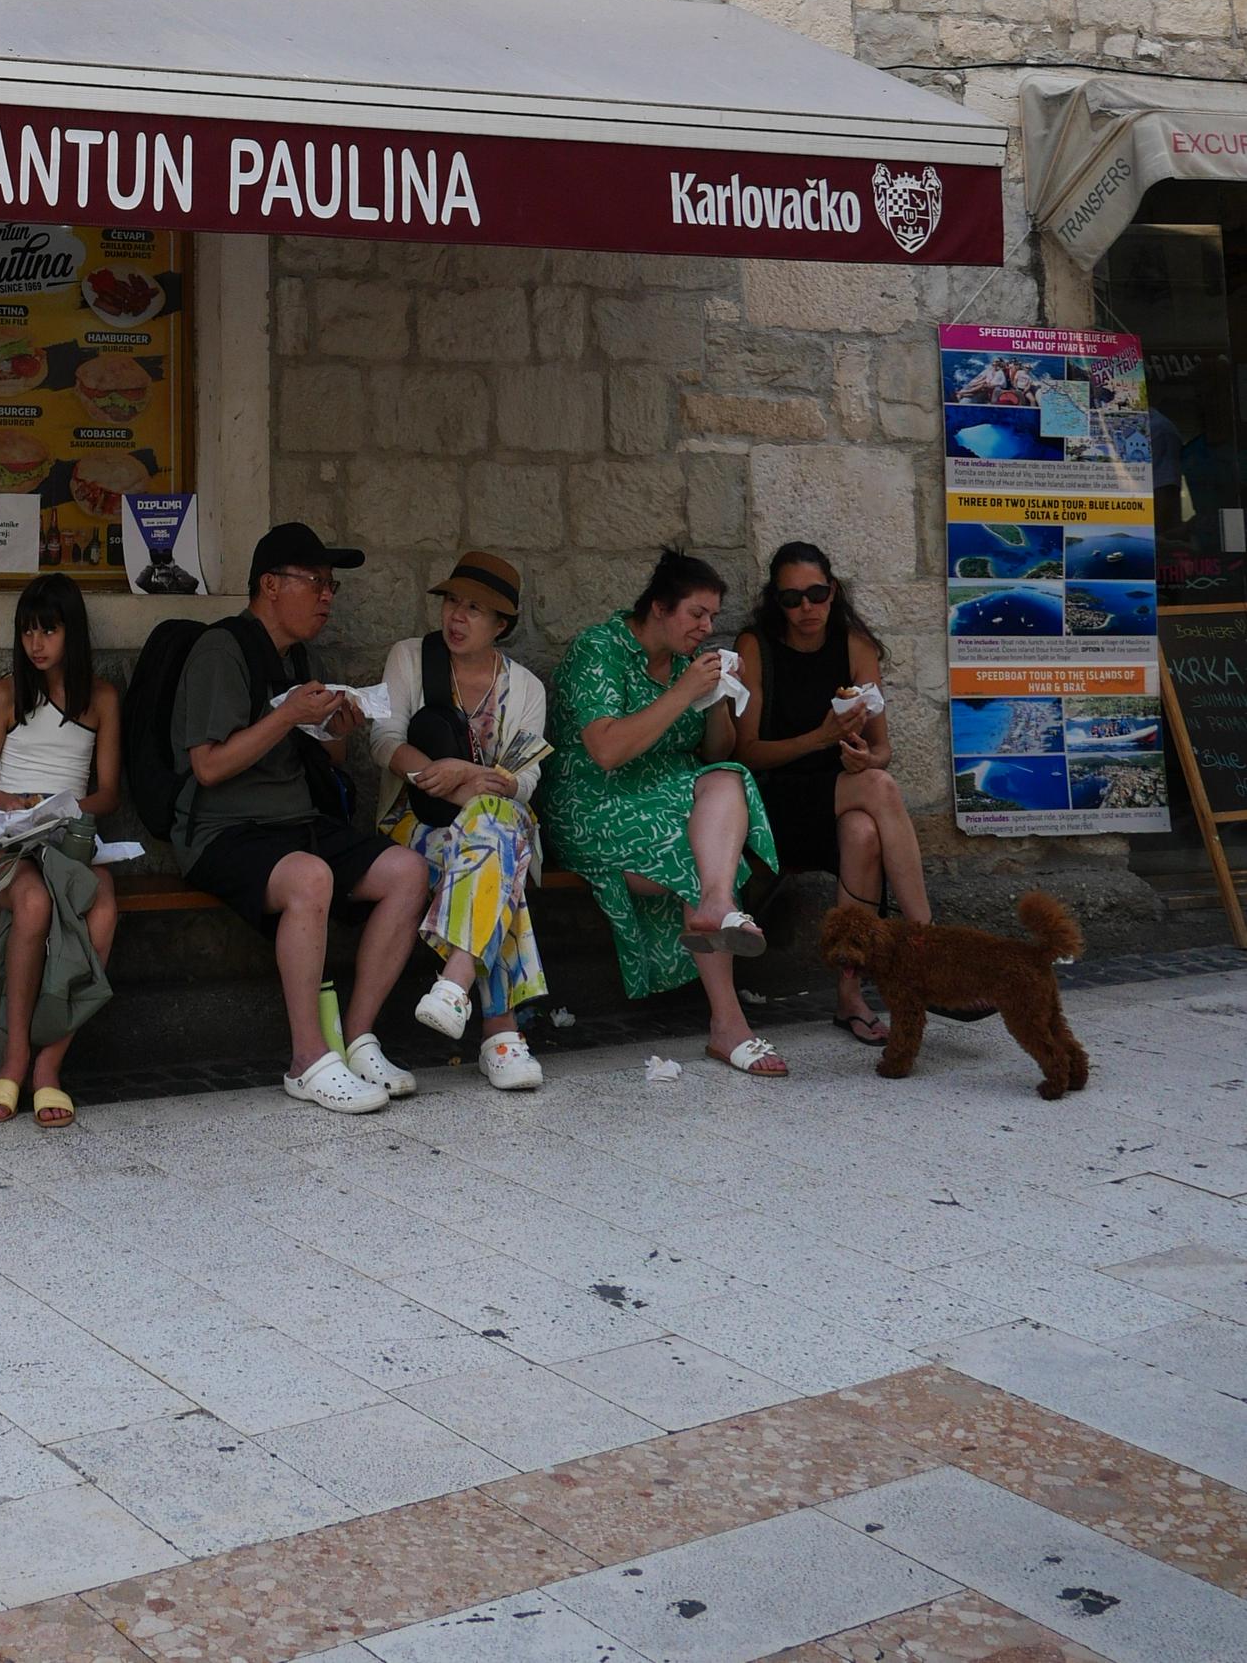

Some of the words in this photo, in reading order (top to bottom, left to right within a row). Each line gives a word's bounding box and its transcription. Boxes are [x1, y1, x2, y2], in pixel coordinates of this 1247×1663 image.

[229, 137, 481, 227] PAULINA
[670, 171, 860, 233] Karlovačko
[1057, 157, 1131, 244] TRANSFERS
[100, 242, 133, 251] GRILLED
[134, 243, 156, 251] MEAT
[105, 250, 152, 259] DUMPLINGS
[0, 283, 22, 293] SINCE
[24, 282, 42, 292] 1969
[88, 333, 149, 344] HAMBURGER
[978, 327, 1033, 339] SPEEDBOAT
[1034, 330, 1056, 340] TOUR
[1057, 331, 1068, 341] TO
[1068, 332, 1082, 342] THE
[1083, 333, 1100, 343] BLUE
[1012, 340, 1043, 351] ISLAND
[1045, 341, 1055, 351] OF
[1057, 342, 1078, 353] HVAR
[1086, 344, 1098, 354] VIS
[1091, 354, 1115, 373] BOOK
[1092, 368, 1115, 386] DAY
[1115, 356, 1139, 375] TRIP
[80, 429, 127, 439] KOBASICE
[954, 459, 970, 467] Price
[136, 500, 182, 510] DIPLOMA
[958, 496, 988, 508] THREE
[990, 497, 1003, 508] OR
[1005, 498, 1026, 508] TWO
[1028, 498, 1060, 509] ISLAND
[1061, 499, 1087, 510] TOUR:
[1088, 500, 1109, 510] BLUE
[1111, 500, 1145, 512] LAGOON,
[1024, 508, 1051, 520] ŠOLTA
[1053, 510, 1059, 521] &
[976, 670, 1027, 681] SPEEDBOAT
[1029, 670, 1053, 681] TOUR
[1054, 670, 1066, 681] TO
[1067, 670, 1084, 681] THE
[1086, 670, 1123, 681] ISLANDS
[1124, 670, 1135, 681] OF
[1171, 656, 1245, 686] KRKA
[1028, 682, 1053, 692] HVAR
[1054, 682, 1061, 692] &
[966, 815, 982, 823] Price
